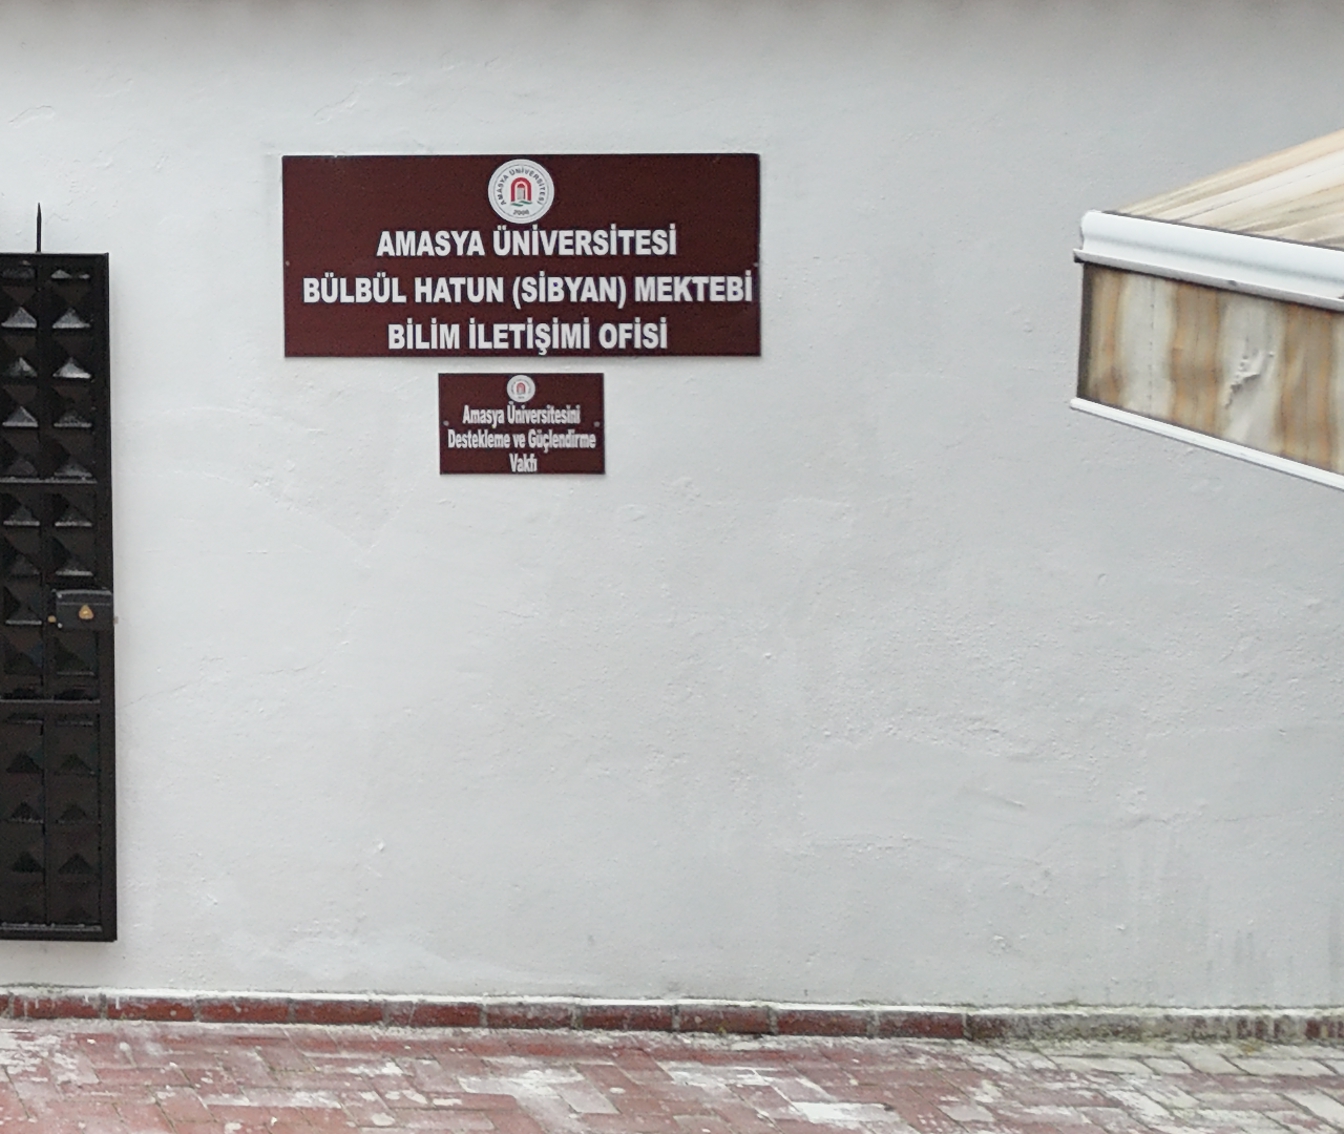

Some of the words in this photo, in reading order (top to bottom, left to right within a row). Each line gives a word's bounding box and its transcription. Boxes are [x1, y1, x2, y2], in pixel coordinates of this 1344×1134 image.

[376, 230, 486, 257] AMASYA
[493, 223, 677, 256] ÜNİVERSİTESİ
[303, 271, 407, 304] BÜLBÜL
[414, 276, 504, 303] HATUN
[512, 270, 627, 310] (SİBYAN)
[634, 269, 753, 302] MEKTEBİ
[388, 317, 460, 350] BİLİM
[468, 316, 591, 356] İLETİŞİMİ
[598, 316, 668, 349] OFİSİ
[462, 404, 505, 429] Amasya
[506, 402, 581, 425] Üniversitesini
[447, 428, 511, 449] Destekleme
[512, 433, 526, 449] ve
[527, 428, 597, 454] Güçlendirme
[509, 453, 538, 473] Vakfı
